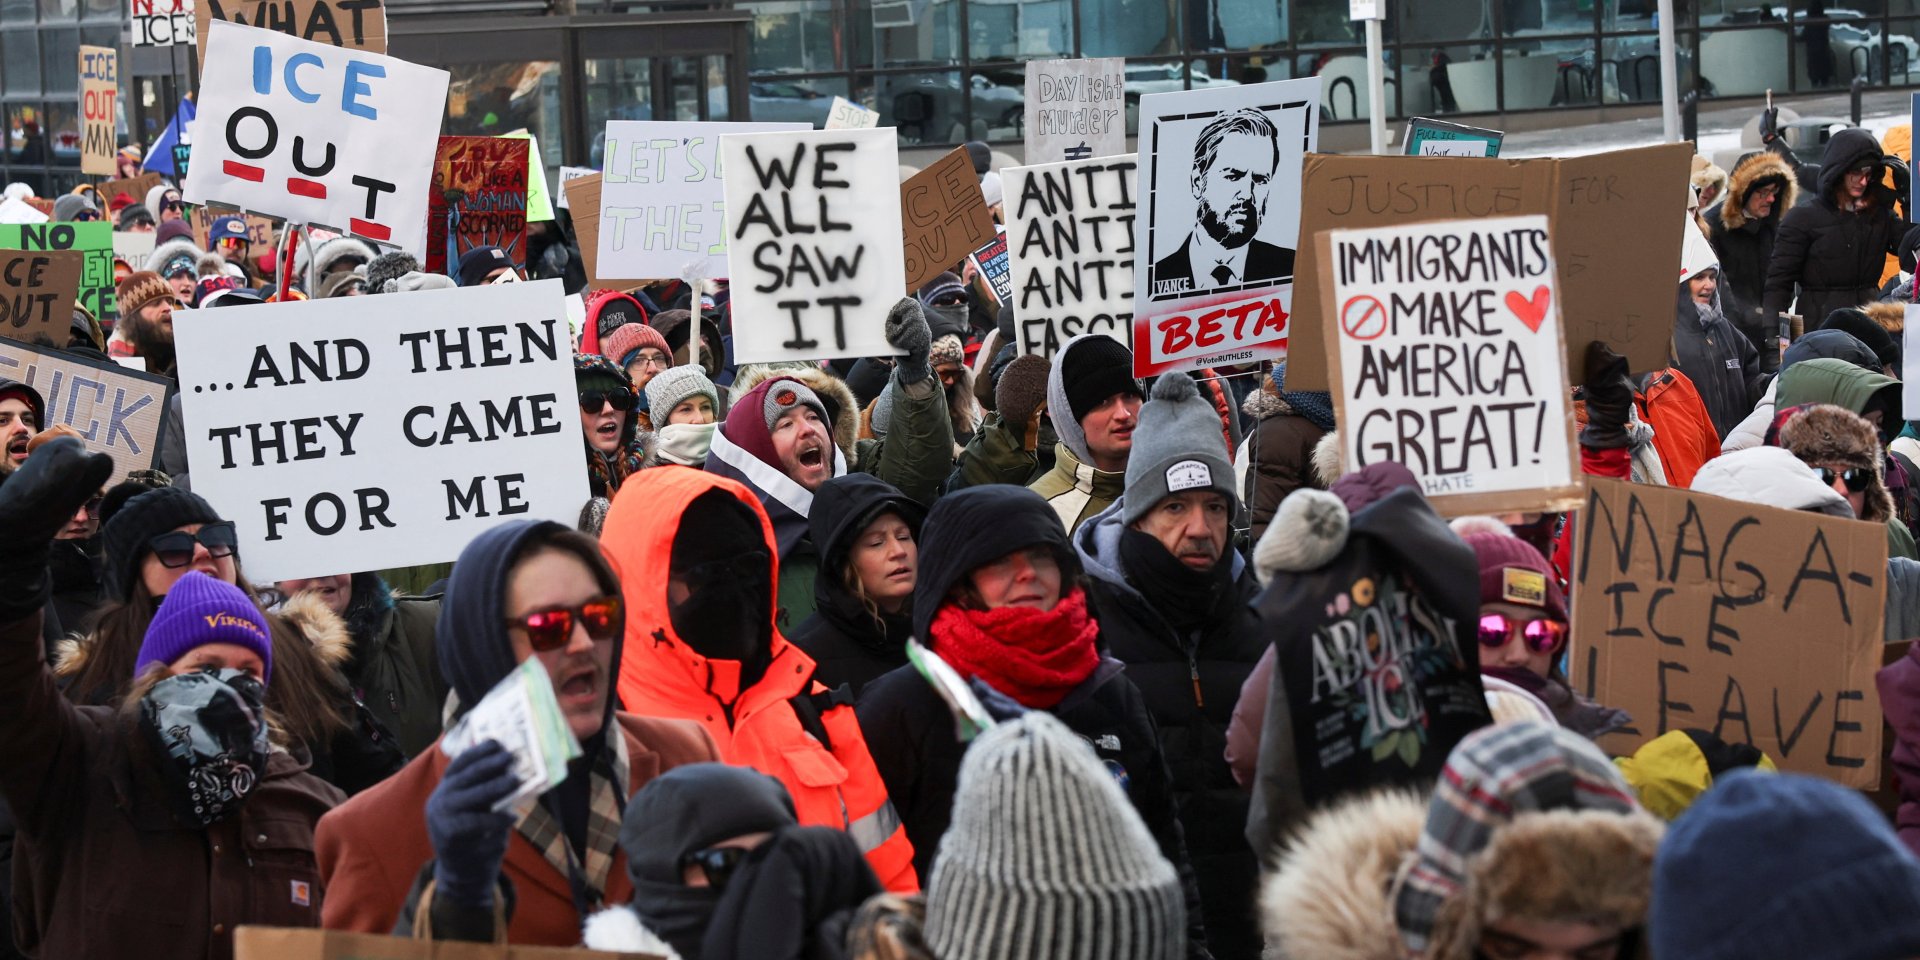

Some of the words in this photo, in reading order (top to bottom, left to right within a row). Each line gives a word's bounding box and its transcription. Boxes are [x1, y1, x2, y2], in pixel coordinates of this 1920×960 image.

[133, 14, 188, 47] ICE
[84, 53, 115, 82] ICE
[252, 46, 387, 121] ICE
[84, 90, 116, 123] OUT
[835, 105, 870, 128] STOP
[85, 125, 115, 159] MN
[225, 106, 397, 220] OUT
[605, 137, 707, 183] LET'S
[483, 172, 507, 188] LIKE
[512, 169, 523, 187] A
[745, 142, 857, 191] WE
[463, 189, 526, 211] WOMAN
[903, 156, 975, 230] CE
[1017, 162, 1136, 219] ANTI
[1327, 175, 1521, 216] JUSTICE
[1569, 175, 1625, 204] FOR
[20, 224, 75, 250] NO
[460, 213, 526, 234] SCORNED
[735, 190, 852, 239] ALL
[1020, 215, 1135, 260] ANTI
[4, 257, 49, 287] CE
[753, 240, 864, 293] SAW
[986, 269, 995, 278] IS
[992, 273, 1008, 286] THAT
[1338, 229, 1548, 286] IMMIGRANTS
[1157, 277, 1190, 294] VANCE
[778, 297, 862, 350] IT
[1157, 298, 1290, 355] BETA
[1390, 289, 1503, 338] MAKE
[399, 319, 558, 374] THEN
[1196, 351, 1253, 366] @VoteRUTHLESS
[1354, 340, 1533, 400] AMERICA
[209, 413, 364, 470] THEY
[403, 393, 562, 448] CAME
[1357, 400, 1546, 477] GREAT!
[261, 487, 397, 542] FOR
[441, 473, 530, 521] ME
[1604, 581, 1741, 656] ICE
